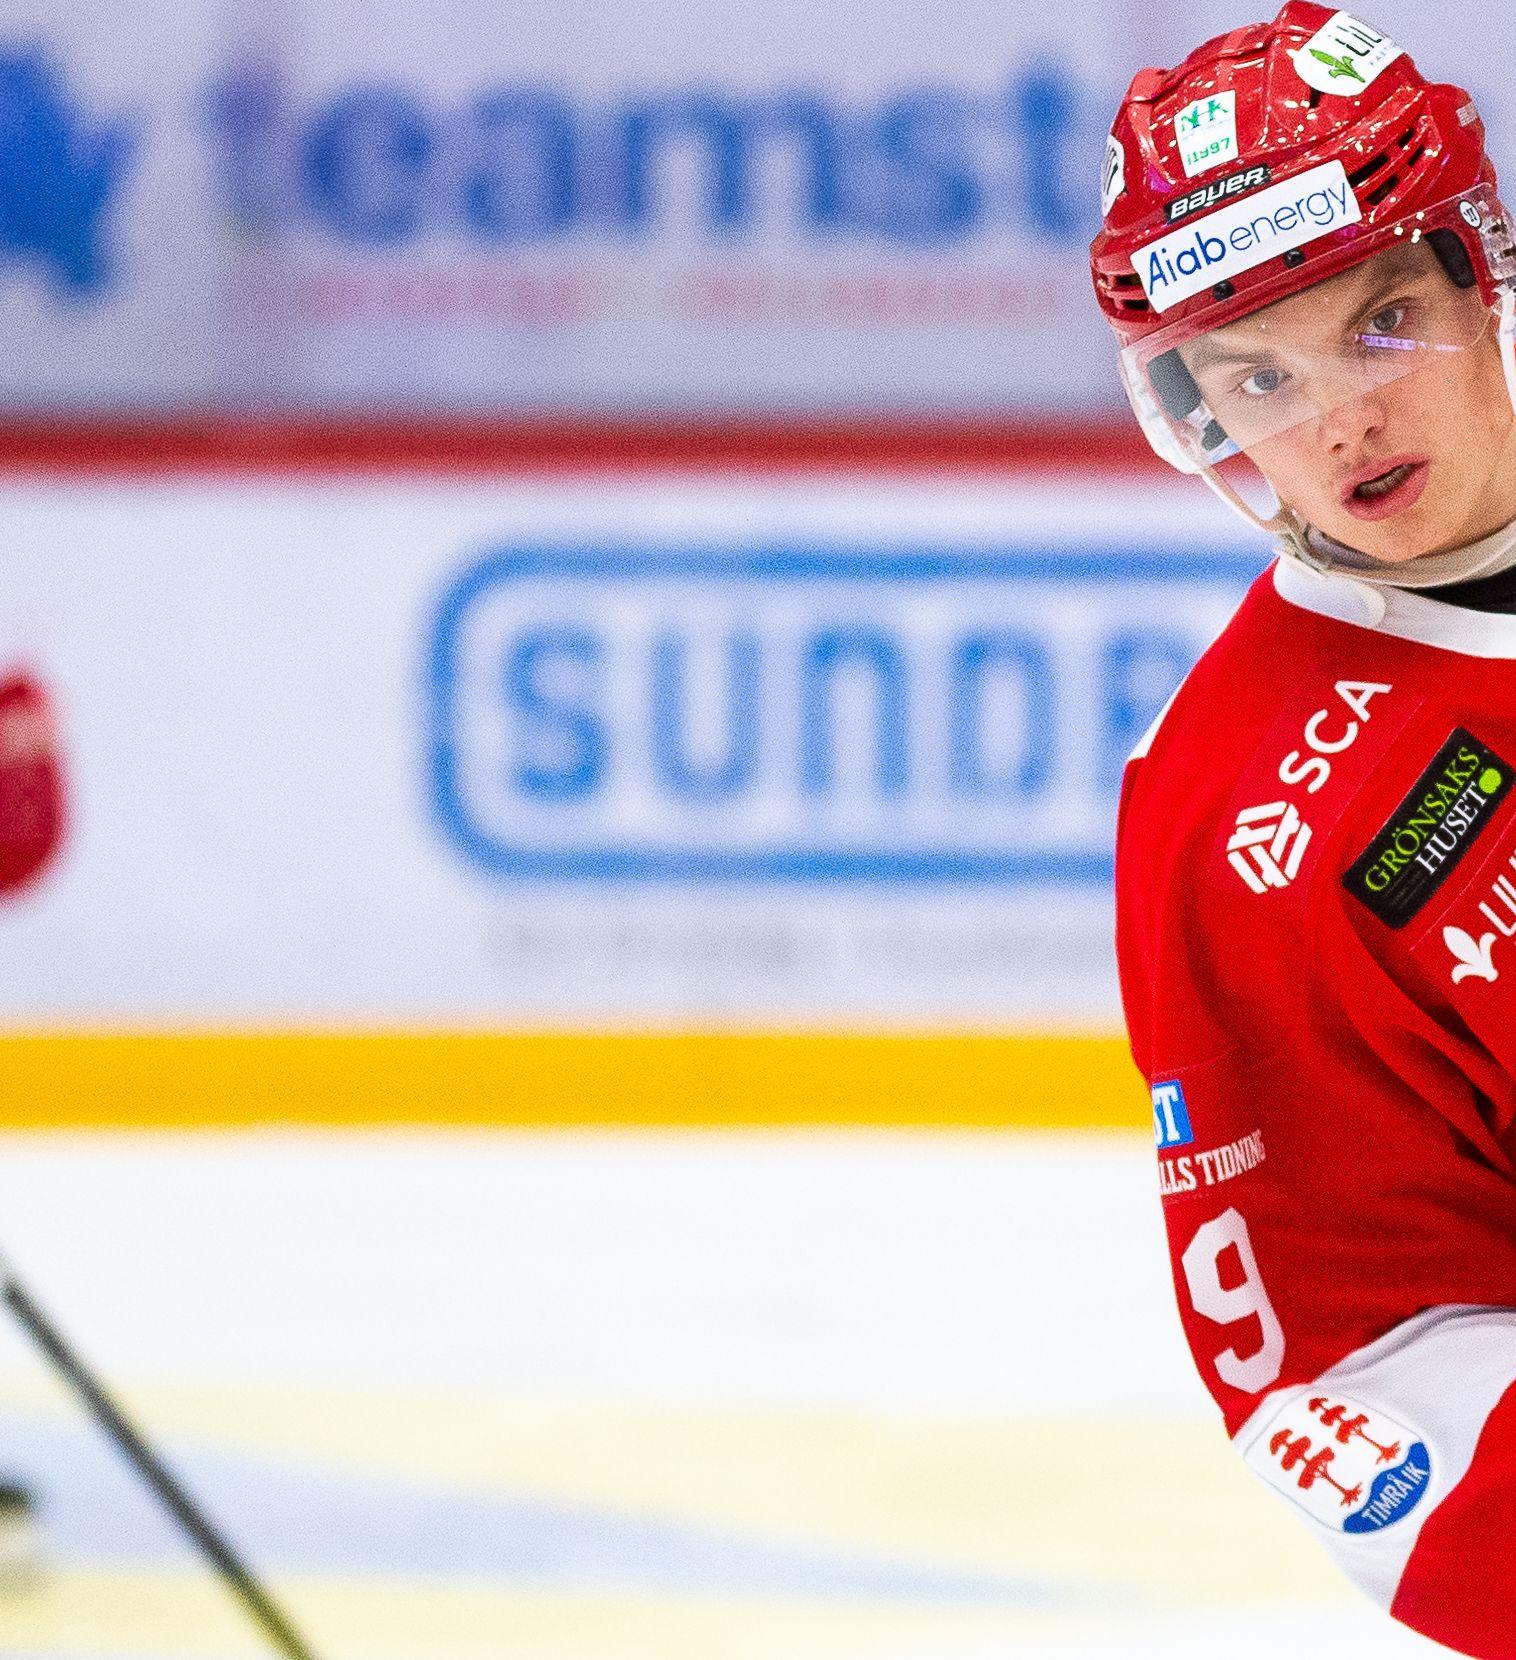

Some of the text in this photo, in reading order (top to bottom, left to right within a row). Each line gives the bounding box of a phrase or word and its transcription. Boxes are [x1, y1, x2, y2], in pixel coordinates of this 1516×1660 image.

[1170, 166, 1268, 220] BAUER
[1278, 679, 1393, 794] SCA
[1365, 746, 1480, 892] GRÖNSAKS
[1415, 780, 1487, 875] HUSET
[1181, 1206, 1287, 1394] 9
[1361, 1462, 1430, 1526] TIMRÅ IK
